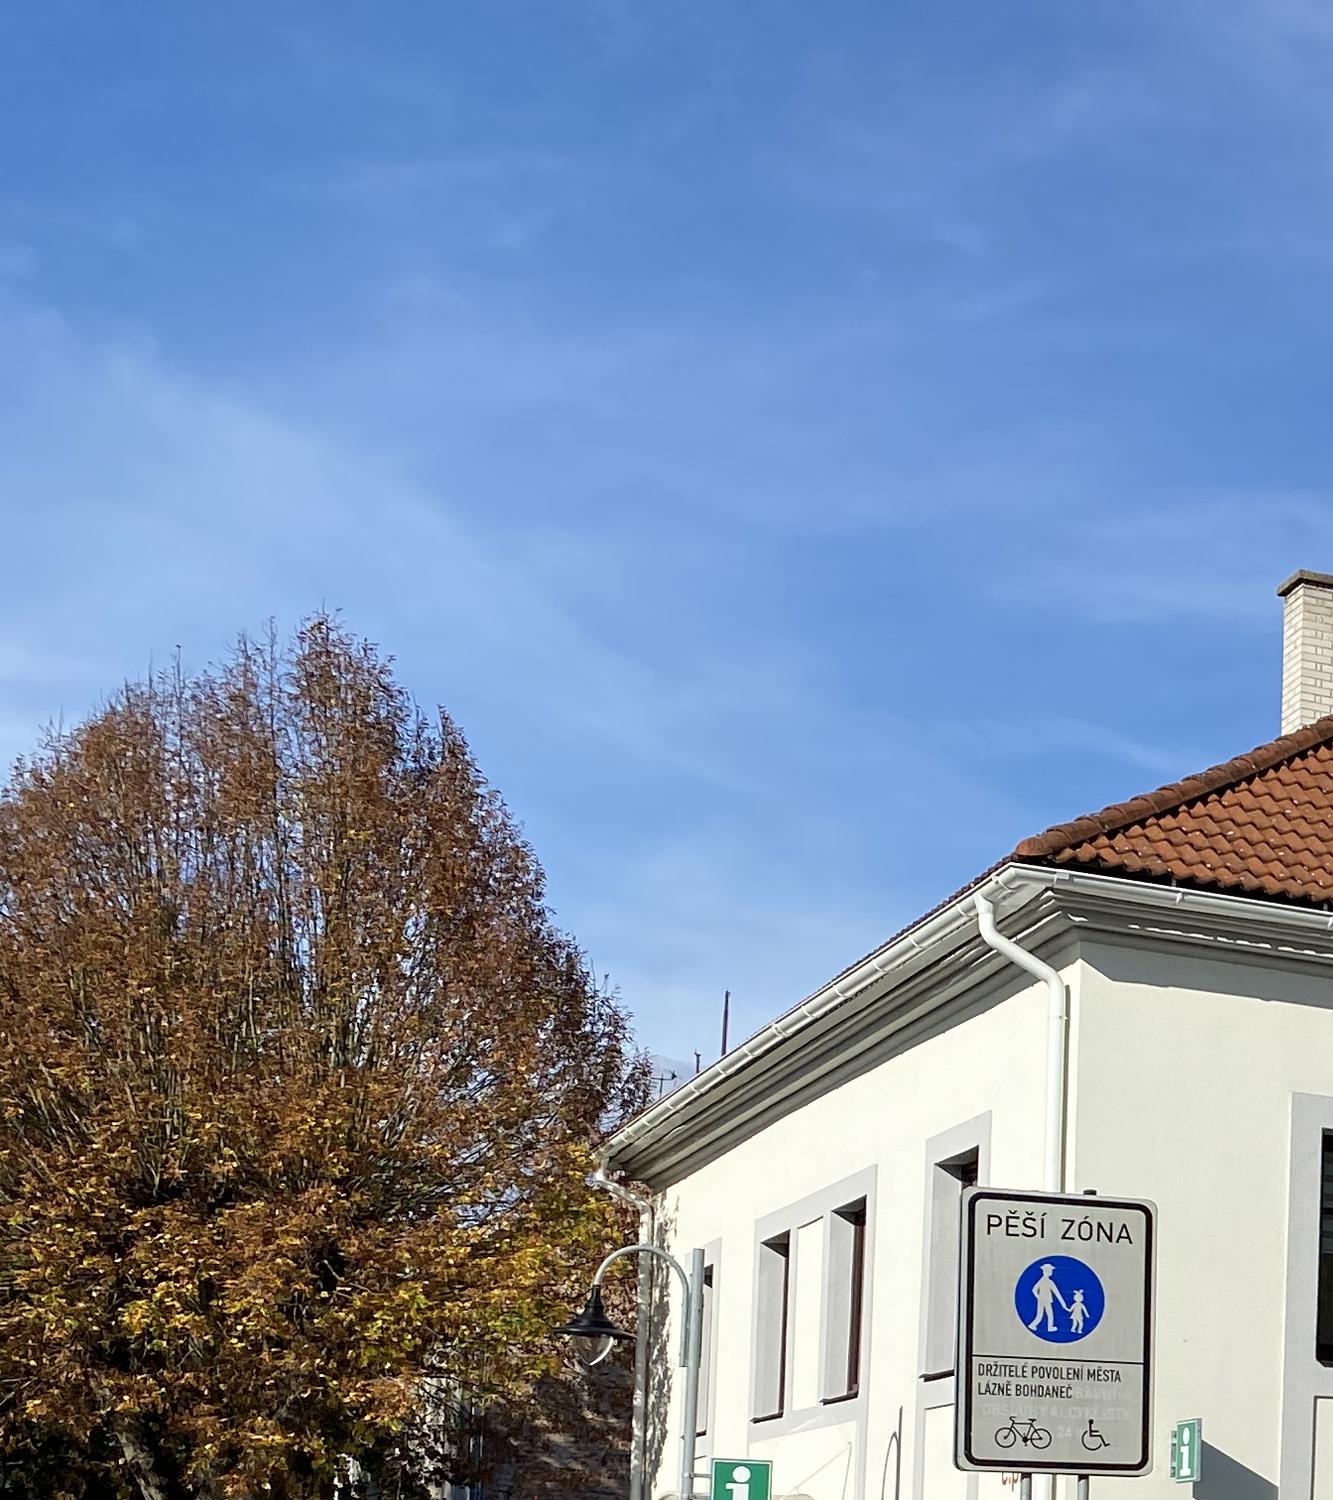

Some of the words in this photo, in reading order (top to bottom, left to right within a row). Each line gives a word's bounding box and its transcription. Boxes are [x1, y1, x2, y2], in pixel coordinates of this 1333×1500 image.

[987, 1210, 1047, 1239] PĚŠÍ
[1061, 1216, 1133, 1244] ZÓNA
[978, 1362, 1028, 1379] DRŽITELÉ
[1031, 1363, 1084, 1381] POVOLENÍ
[1087, 1367, 1121, 1383] MĚSTA
[978, 1380, 1011, 1396] LÁZNĚ
